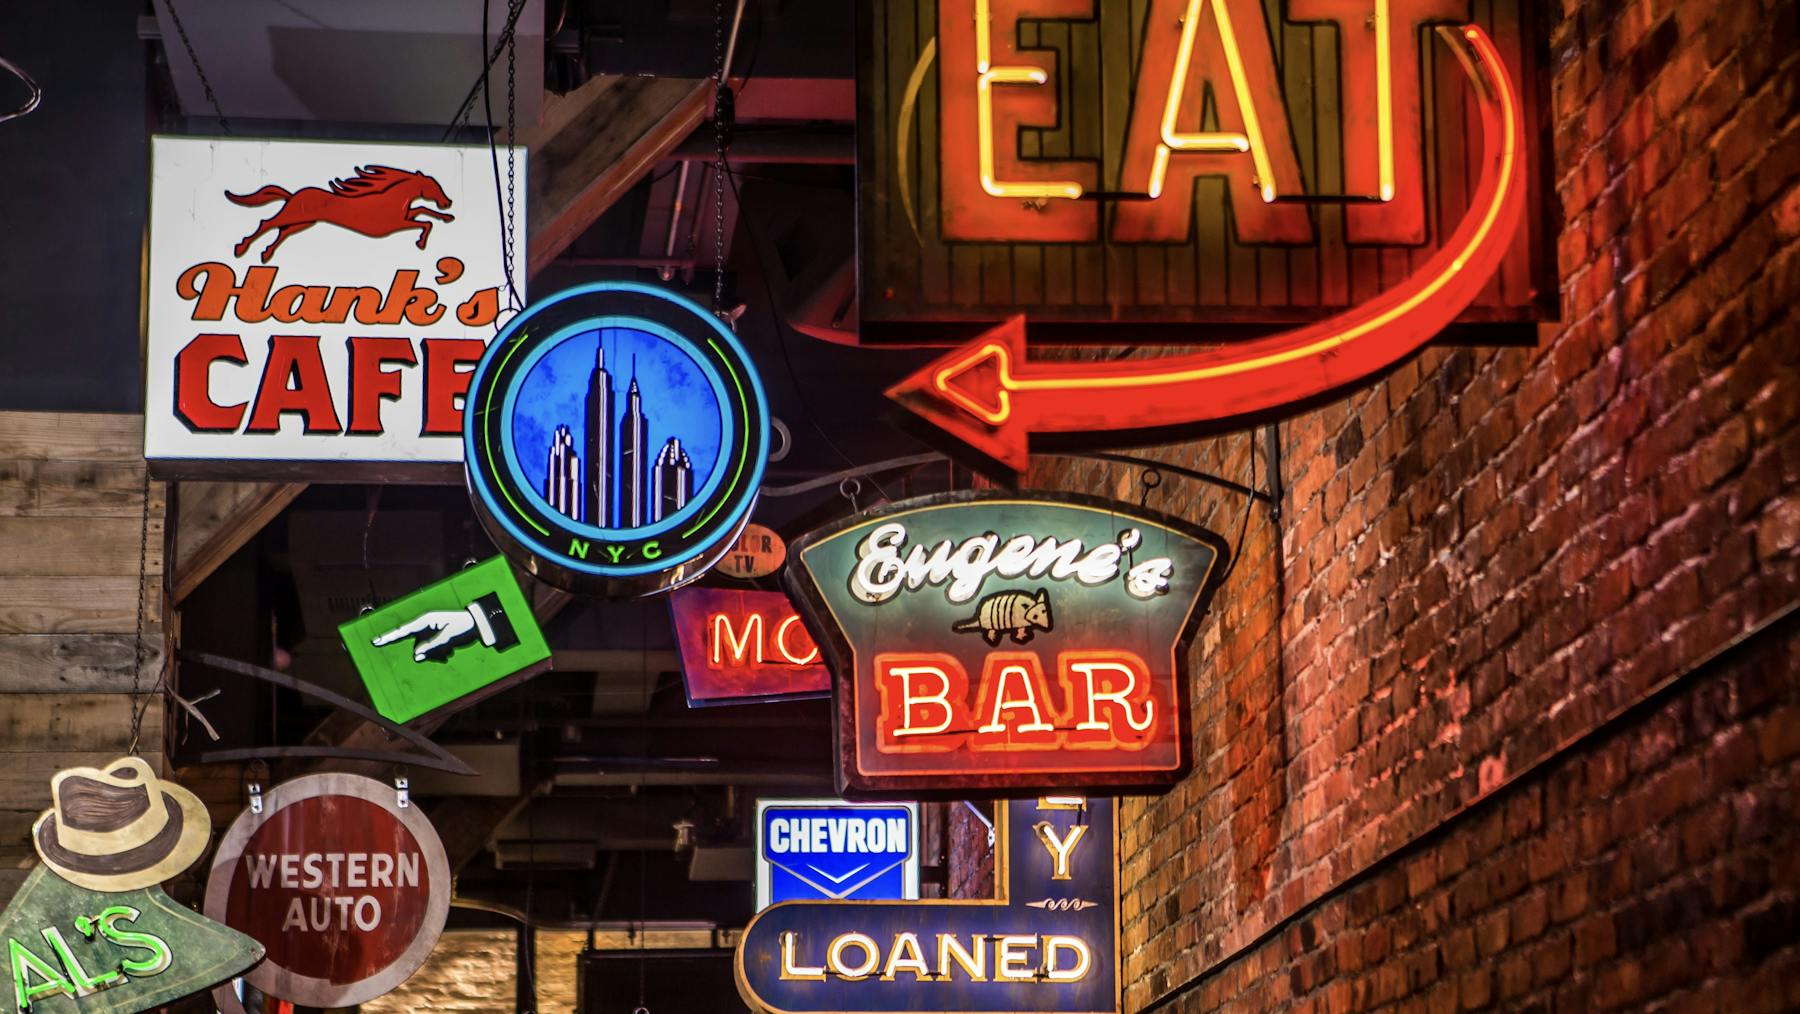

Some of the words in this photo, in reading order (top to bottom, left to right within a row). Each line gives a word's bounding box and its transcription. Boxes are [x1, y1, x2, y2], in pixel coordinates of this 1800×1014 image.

[938, 0, 1470, 244] EAT
[176, 256, 499, 326] Hank's
[173, 333, 489, 437] CAFE
[568, 538, 662, 563] NYC
[734, 554, 755, 573] TV
[848, 522, 1174, 604] Eugene's
[873, 651, 1157, 753] BAR
[770, 817, 907, 853] CHEVRON
[246, 852, 420, 888] WESTERN
[282, 895, 382, 932] AUTO
[8, 905, 173, 1014] AL'S
[779, 932, 1092, 983] LOANED
